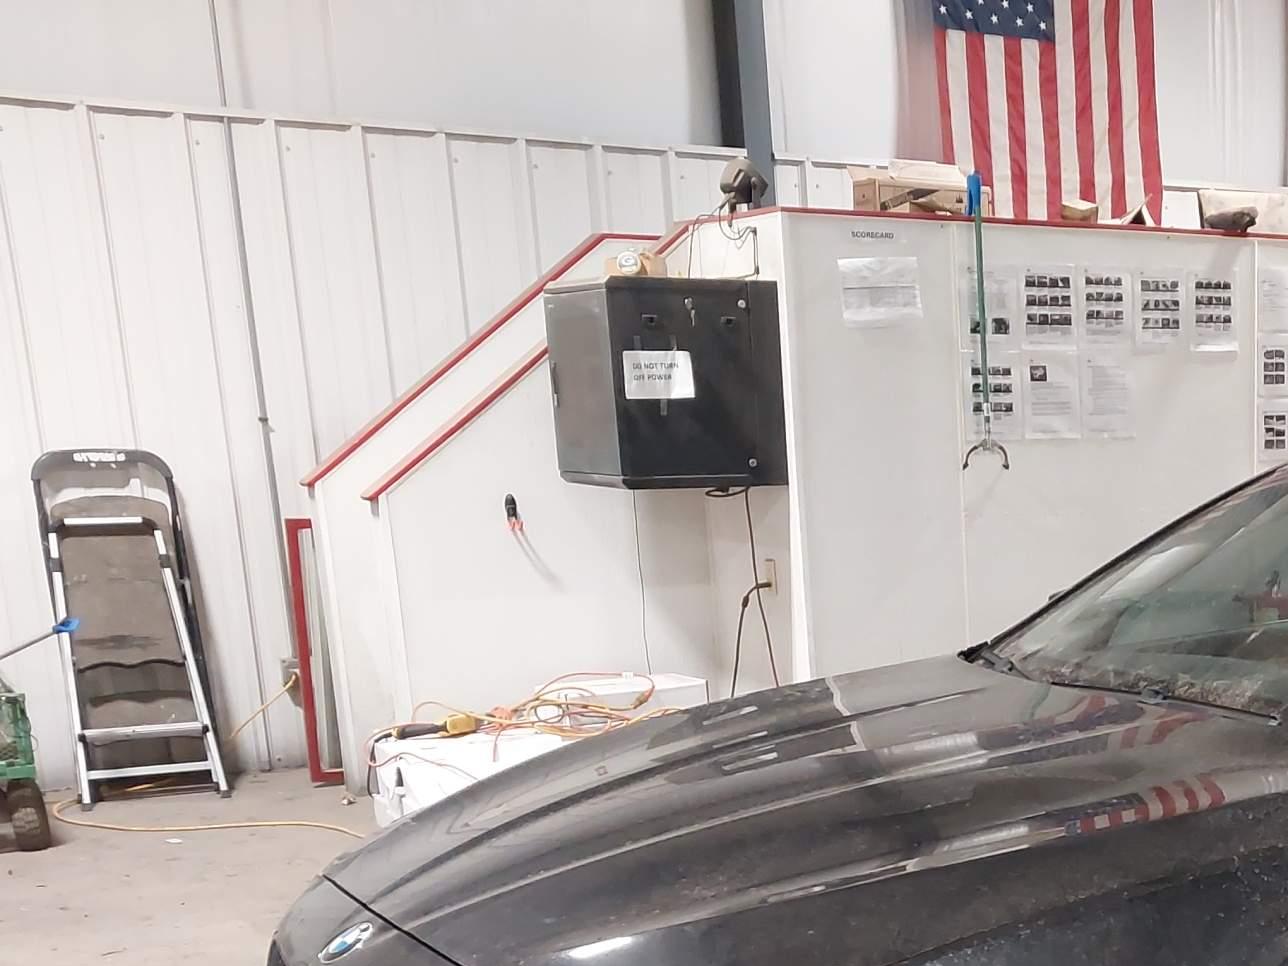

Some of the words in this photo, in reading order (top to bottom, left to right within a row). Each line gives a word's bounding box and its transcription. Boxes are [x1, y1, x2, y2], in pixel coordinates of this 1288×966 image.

[851, 231, 895, 239] SCORECARD
[632, 362, 642, 370] DO
[643, 362, 658, 370] NOT
